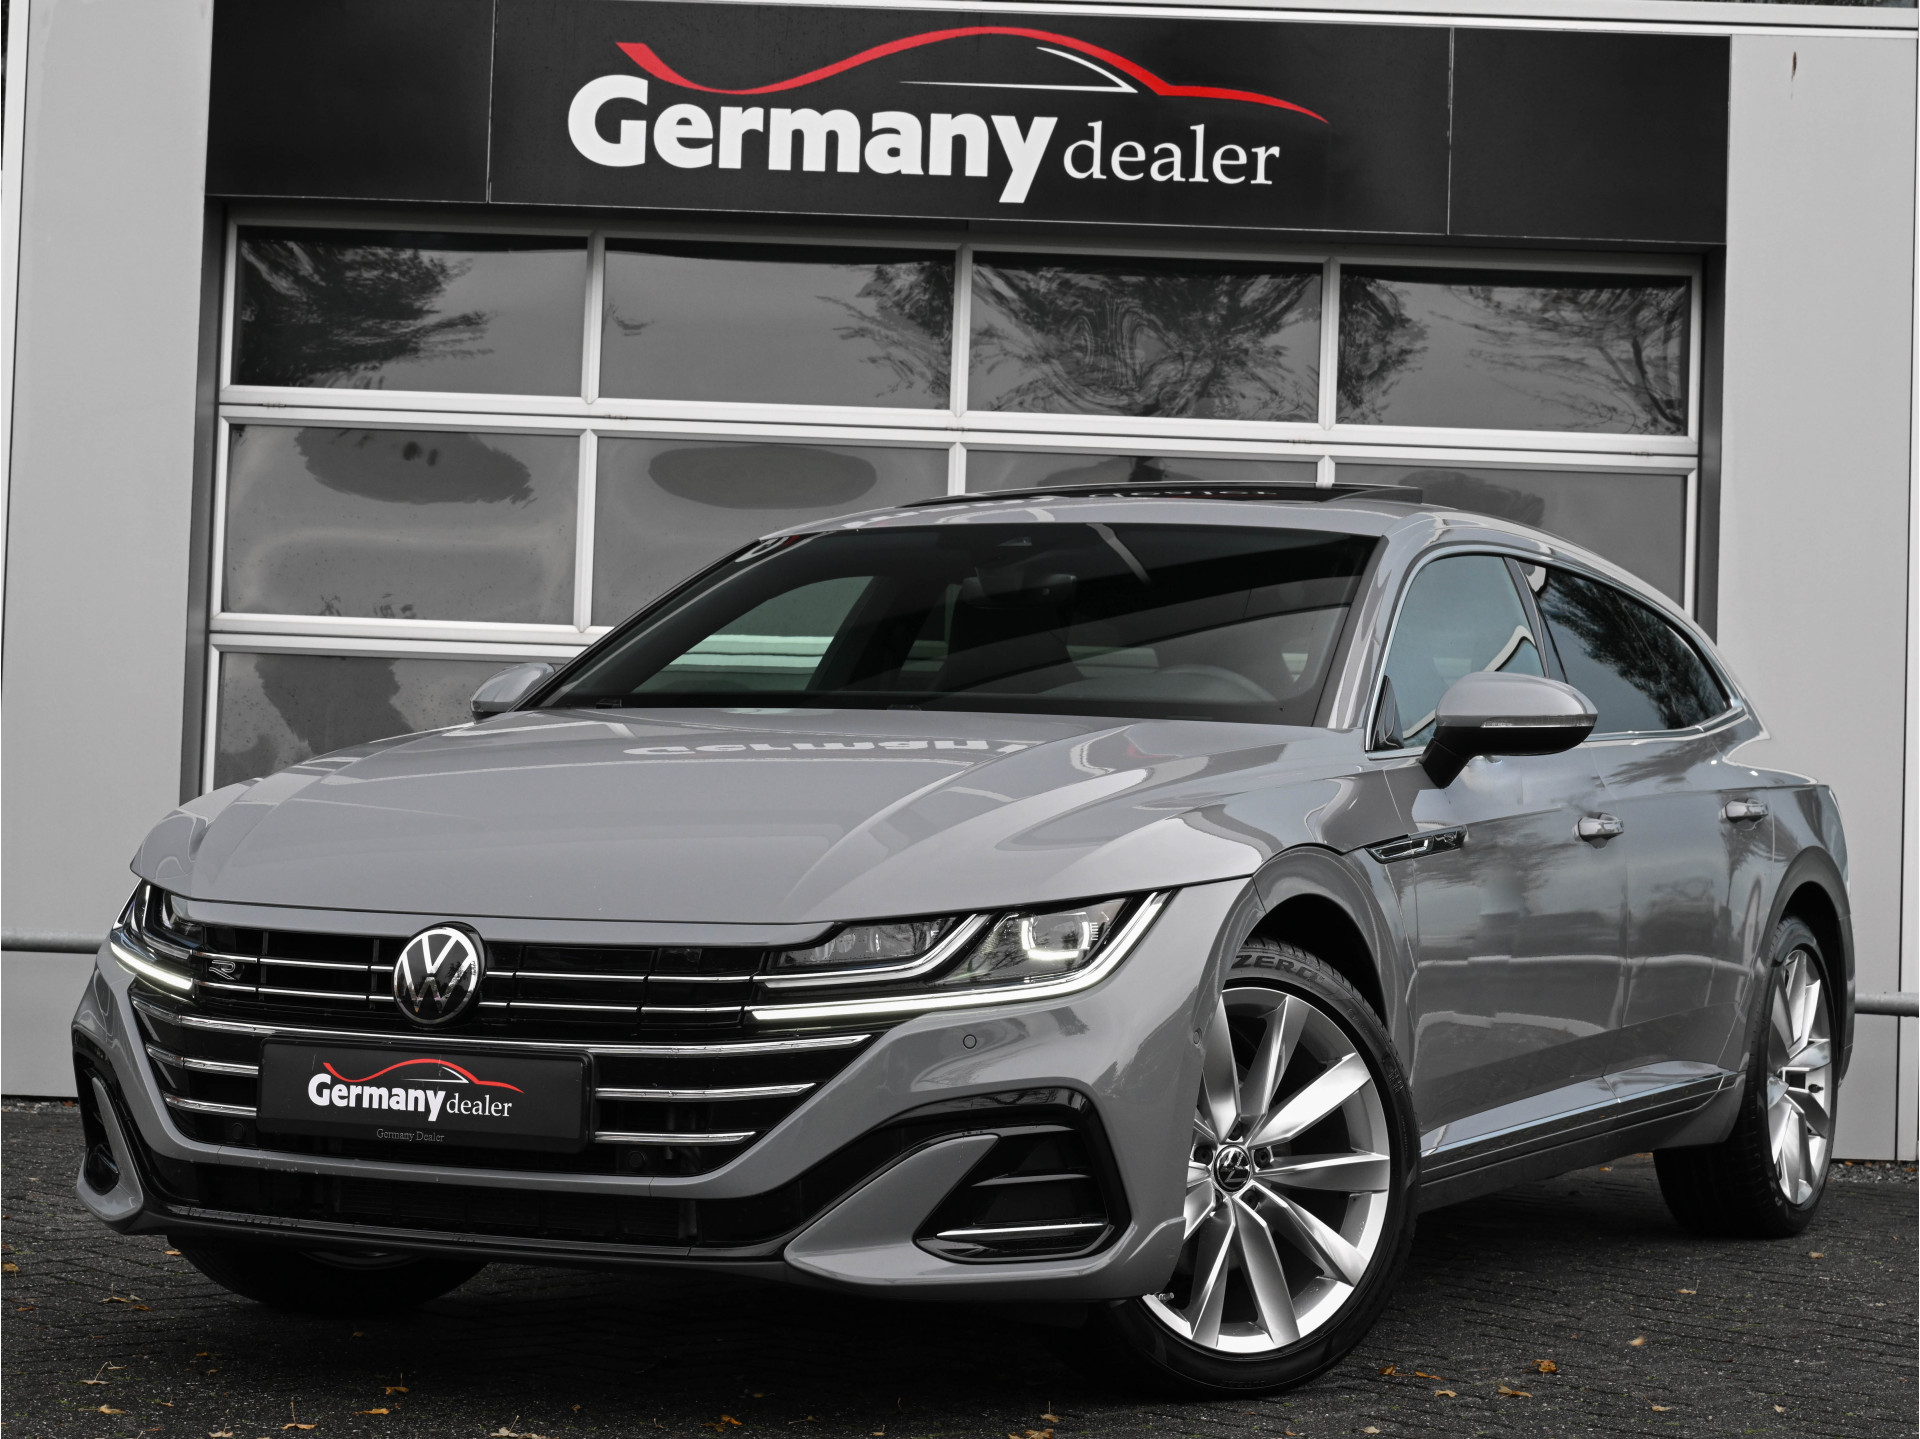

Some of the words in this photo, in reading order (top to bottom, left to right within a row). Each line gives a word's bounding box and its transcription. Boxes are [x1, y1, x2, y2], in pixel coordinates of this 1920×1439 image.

[567, 74, 1058, 203] Germany
[1063, 121, 1281, 185] dealer
[397, 929, 476, 1017] VW
[307, 1073, 447, 1122] Germany
[446, 1093, 513, 1117] dealer
[376, 1128, 415, 1142] Germany
[415, 1131, 445, 1143] Dealer
